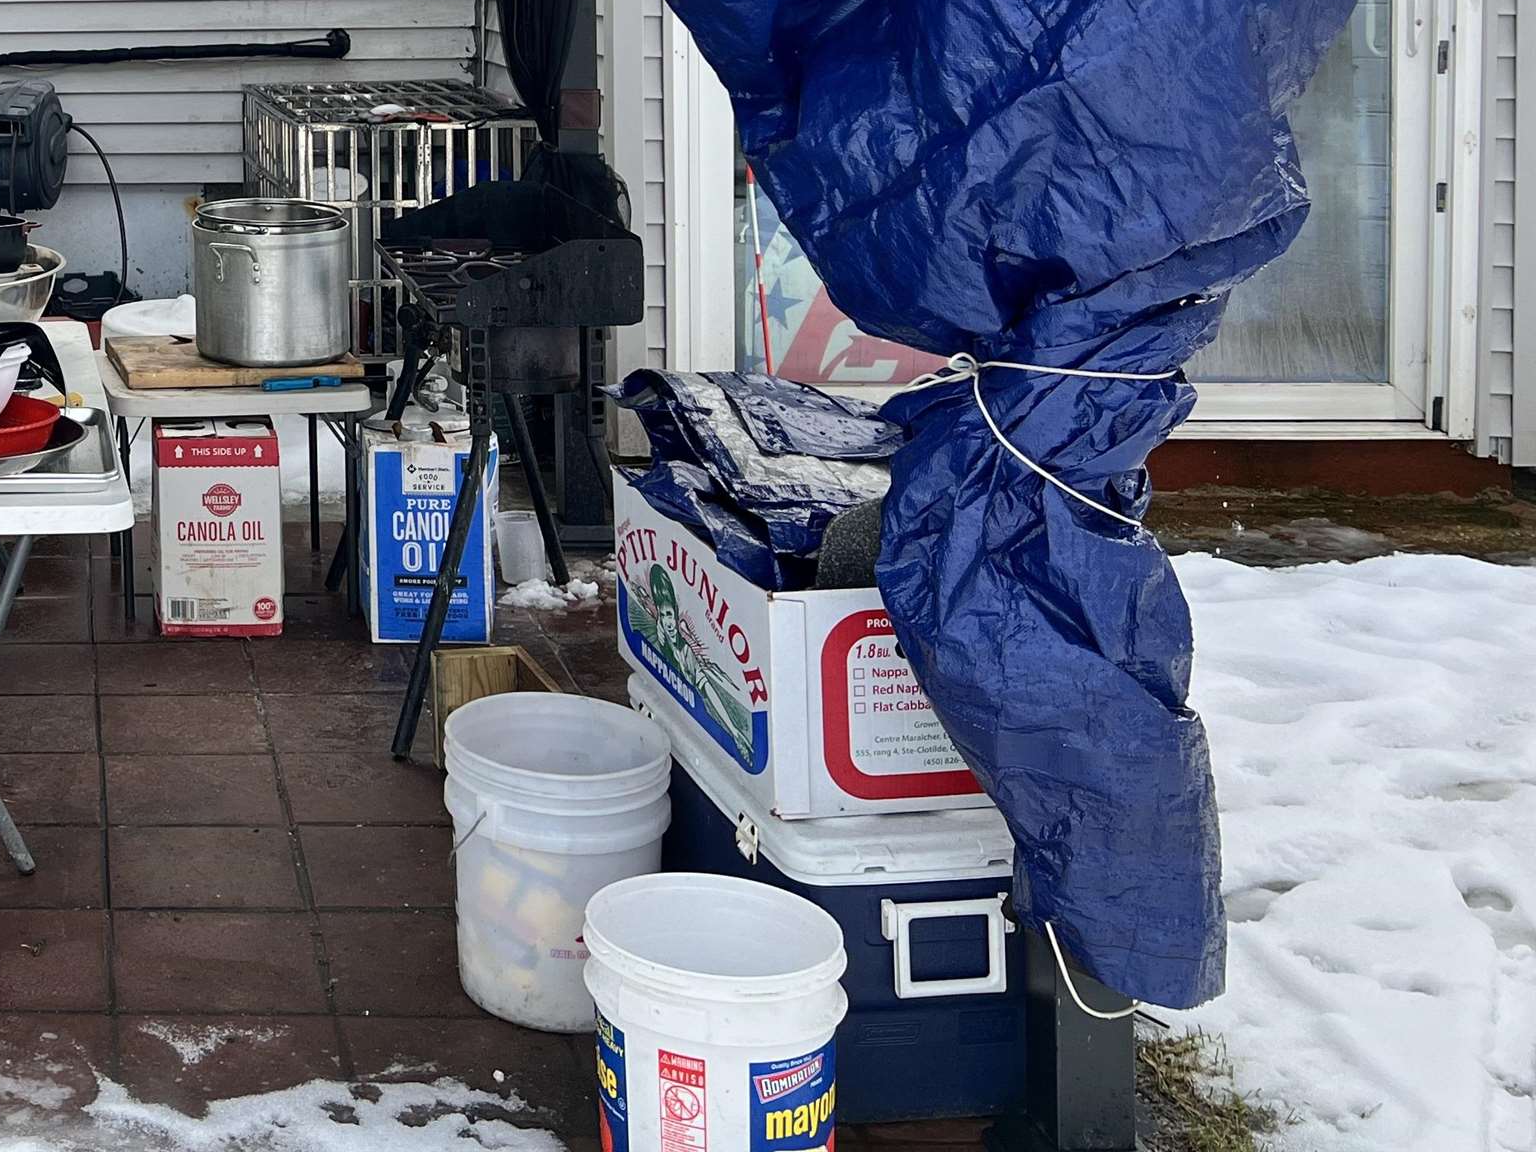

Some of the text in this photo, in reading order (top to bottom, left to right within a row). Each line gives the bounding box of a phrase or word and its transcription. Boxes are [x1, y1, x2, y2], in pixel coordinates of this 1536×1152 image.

[191, 447, 247, 456] THIS SIDE UP
[204, 495, 240, 505] WELLSLEY
[406, 498, 452, 510] PURE
[177, 520, 265, 542] CANOLA OIL
[392, 511, 449, 541] CANO
[402, 541, 447, 572] OI
[617, 528, 768, 707] P'TIT JUNIOR
[705, 609, 725, 644] Brand
[855, 643, 891, 659] 1.8 BU.
[872, 667, 908, 680] Nappa
[872, 683, 924, 697] Red Nap
[873, 700, 931, 713] Flat Cabba
[913, 720, 940, 729] Grown
[874, 735, 900, 744] Centre
[873, 749, 892, 757] rang
[901, 744, 949, 755] Ste-Clotilde,
[923, 756, 966, 767] (450) 826-
[670, 1055, 704, 1072] WARNING
[671, 1070, 704, 1086] AVISO
[761, 1060, 820, 1097] ADMIRATION
[766, 1081, 836, 1139] mayon
